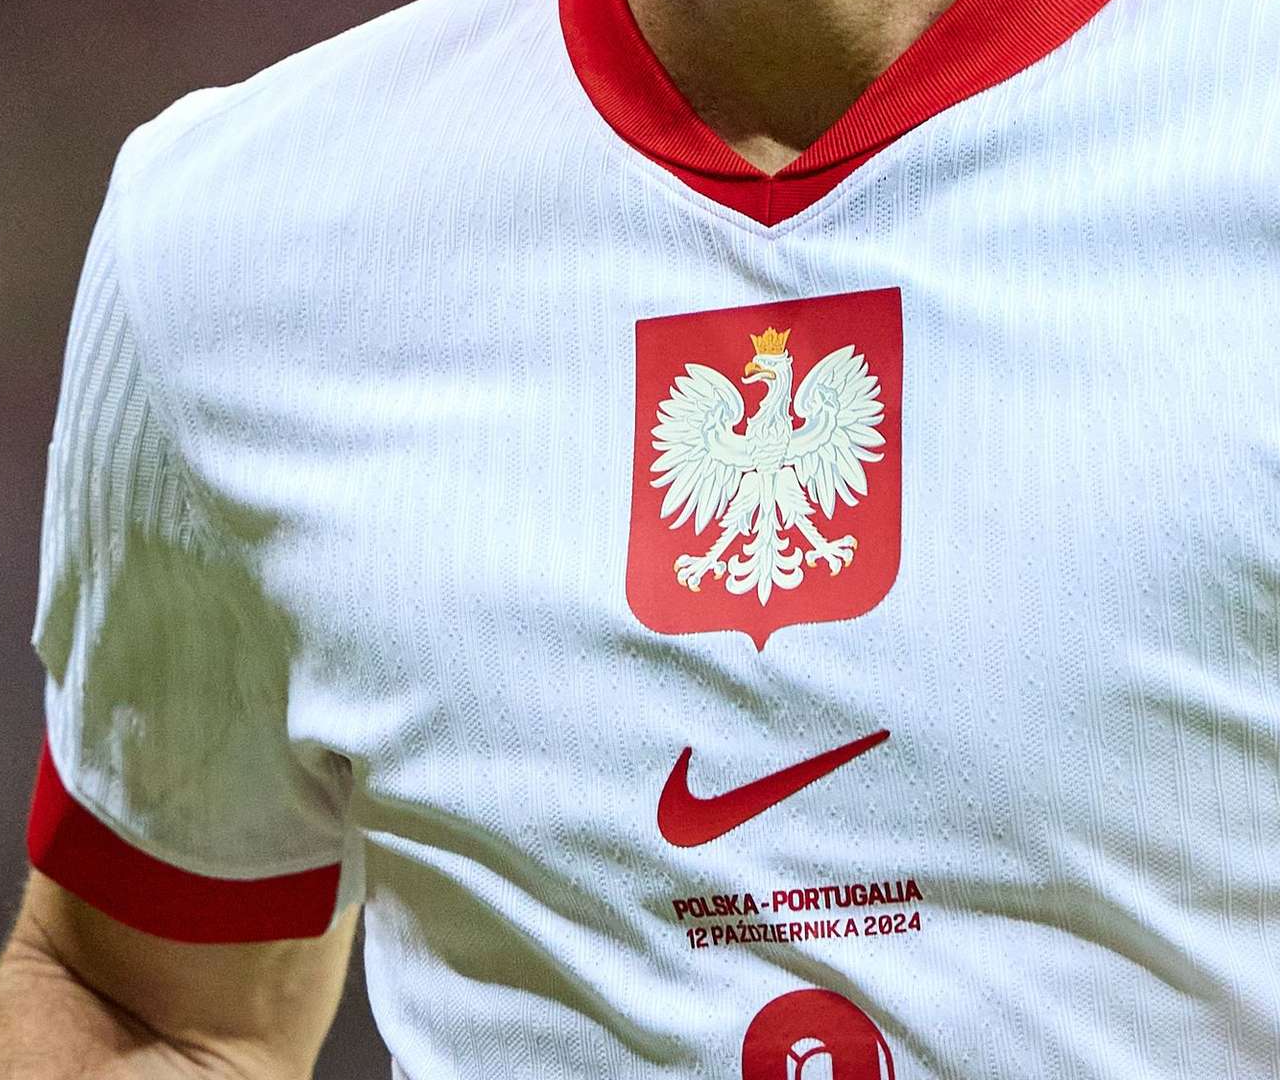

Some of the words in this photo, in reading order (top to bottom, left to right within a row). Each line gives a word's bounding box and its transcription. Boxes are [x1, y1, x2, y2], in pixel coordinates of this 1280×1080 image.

[686, 928, 709, 950] 12
[711, 918, 859, 946] PAŹDZIERNIKA
[863, 911, 921, 937] 2024
